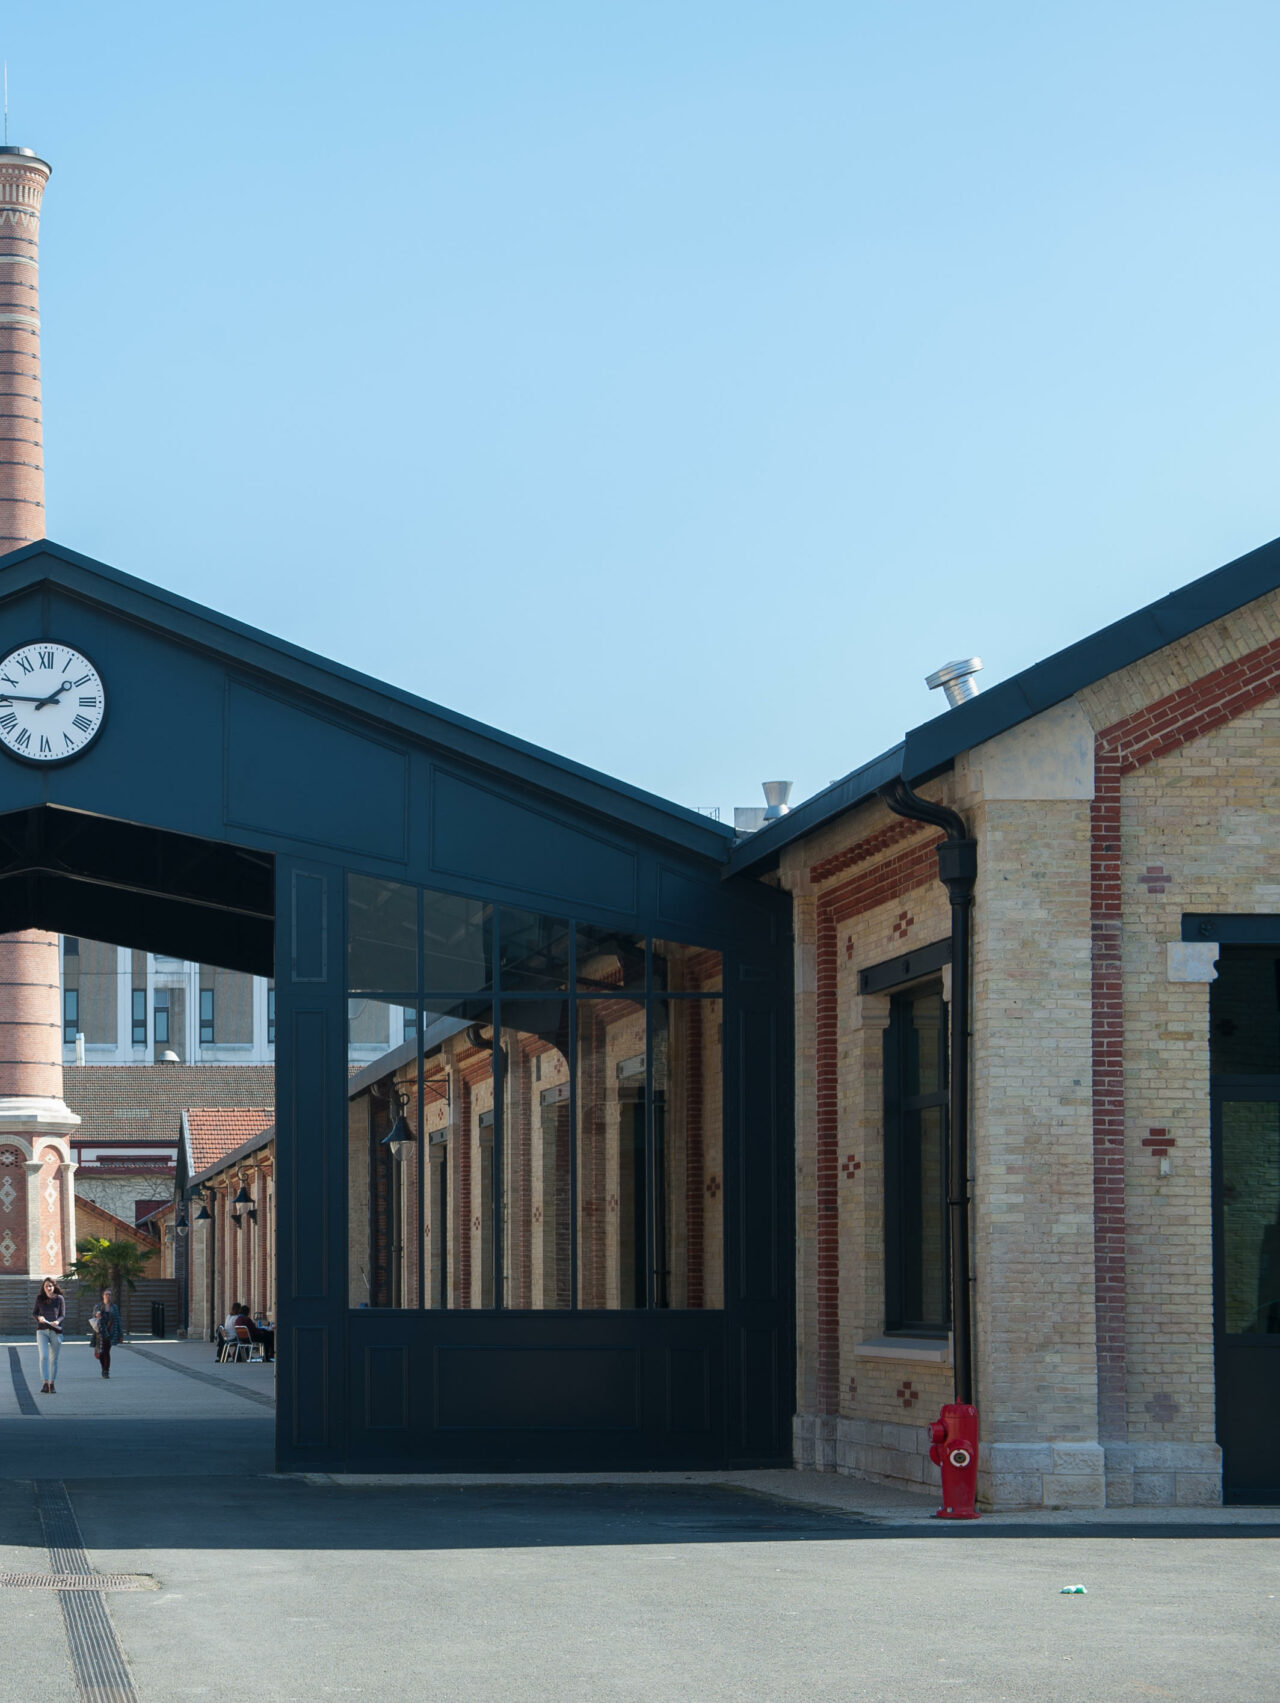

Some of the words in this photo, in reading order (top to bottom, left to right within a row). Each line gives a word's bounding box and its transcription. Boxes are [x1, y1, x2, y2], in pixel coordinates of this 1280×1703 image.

[16, 656, 35, 676] XI
[38, 651, 54, 670] XII
[62, 658, 72, 673] I
[1, 673, 19, 688] X
[73, 674, 91, 688] II
[78, 697, 96, 707] III
[72, 714, 93, 733] IIII
[14, 728, 32, 749] VII
[40, 734, 52, 752] VI
[63, 731, 74, 748] V
